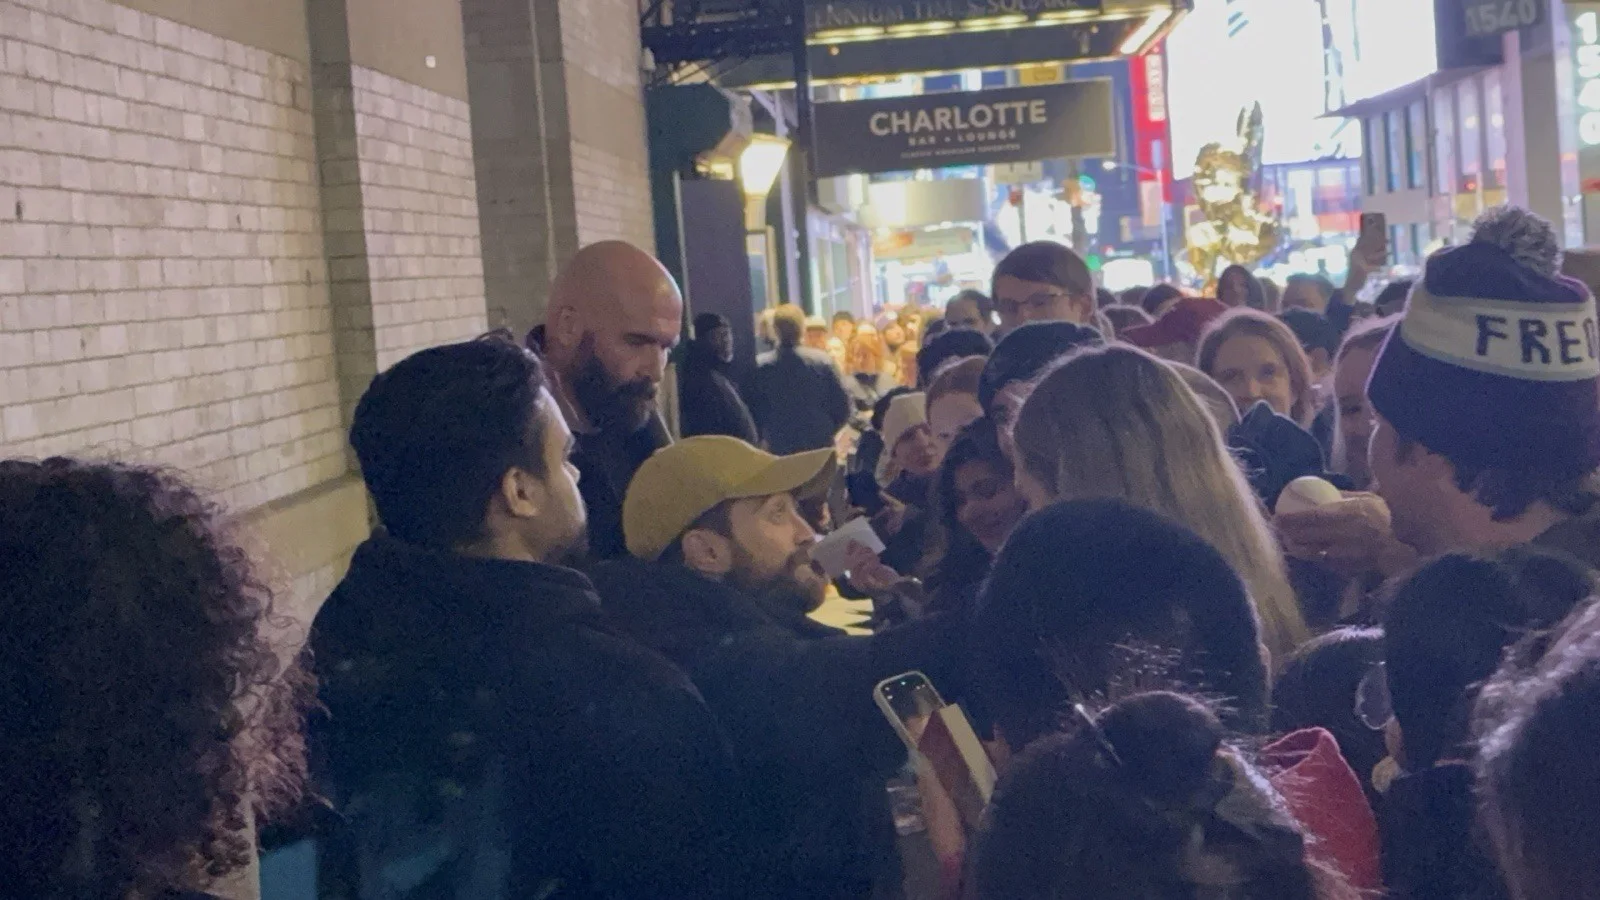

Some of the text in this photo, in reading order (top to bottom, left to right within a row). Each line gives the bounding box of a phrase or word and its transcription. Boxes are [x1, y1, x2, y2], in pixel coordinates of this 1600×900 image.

[1466, 0, 1537, 32] 1540
[869, 99, 1048, 137] CHARLOTTE
[908, 128, 1017, 147] BAR LOUNGE
